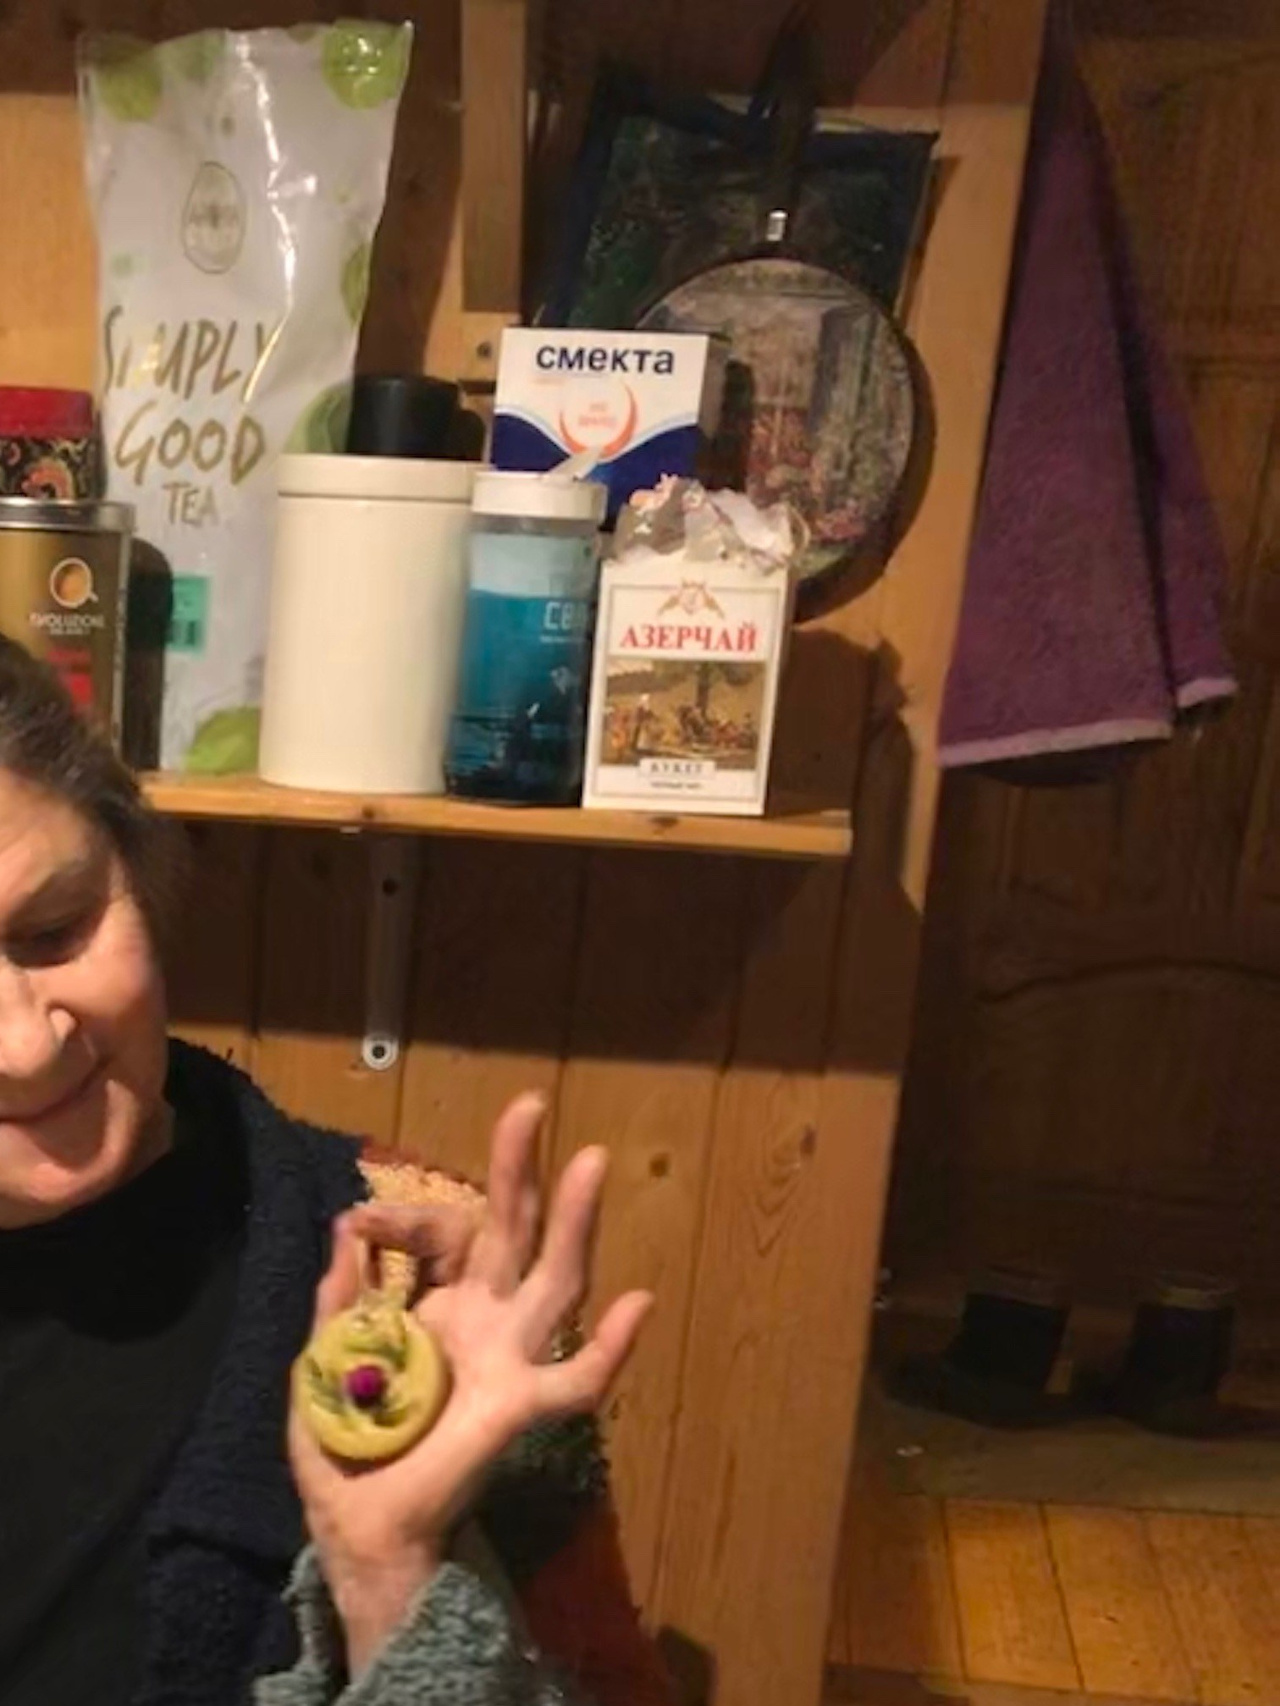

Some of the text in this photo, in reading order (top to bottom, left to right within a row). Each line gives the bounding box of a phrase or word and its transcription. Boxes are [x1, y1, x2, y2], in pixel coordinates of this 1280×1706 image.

[115, 400, 266, 487] GOOD
[161, 481, 219, 527] TEA
[619, 620, 759, 654] АЗЕРЧАЙ
